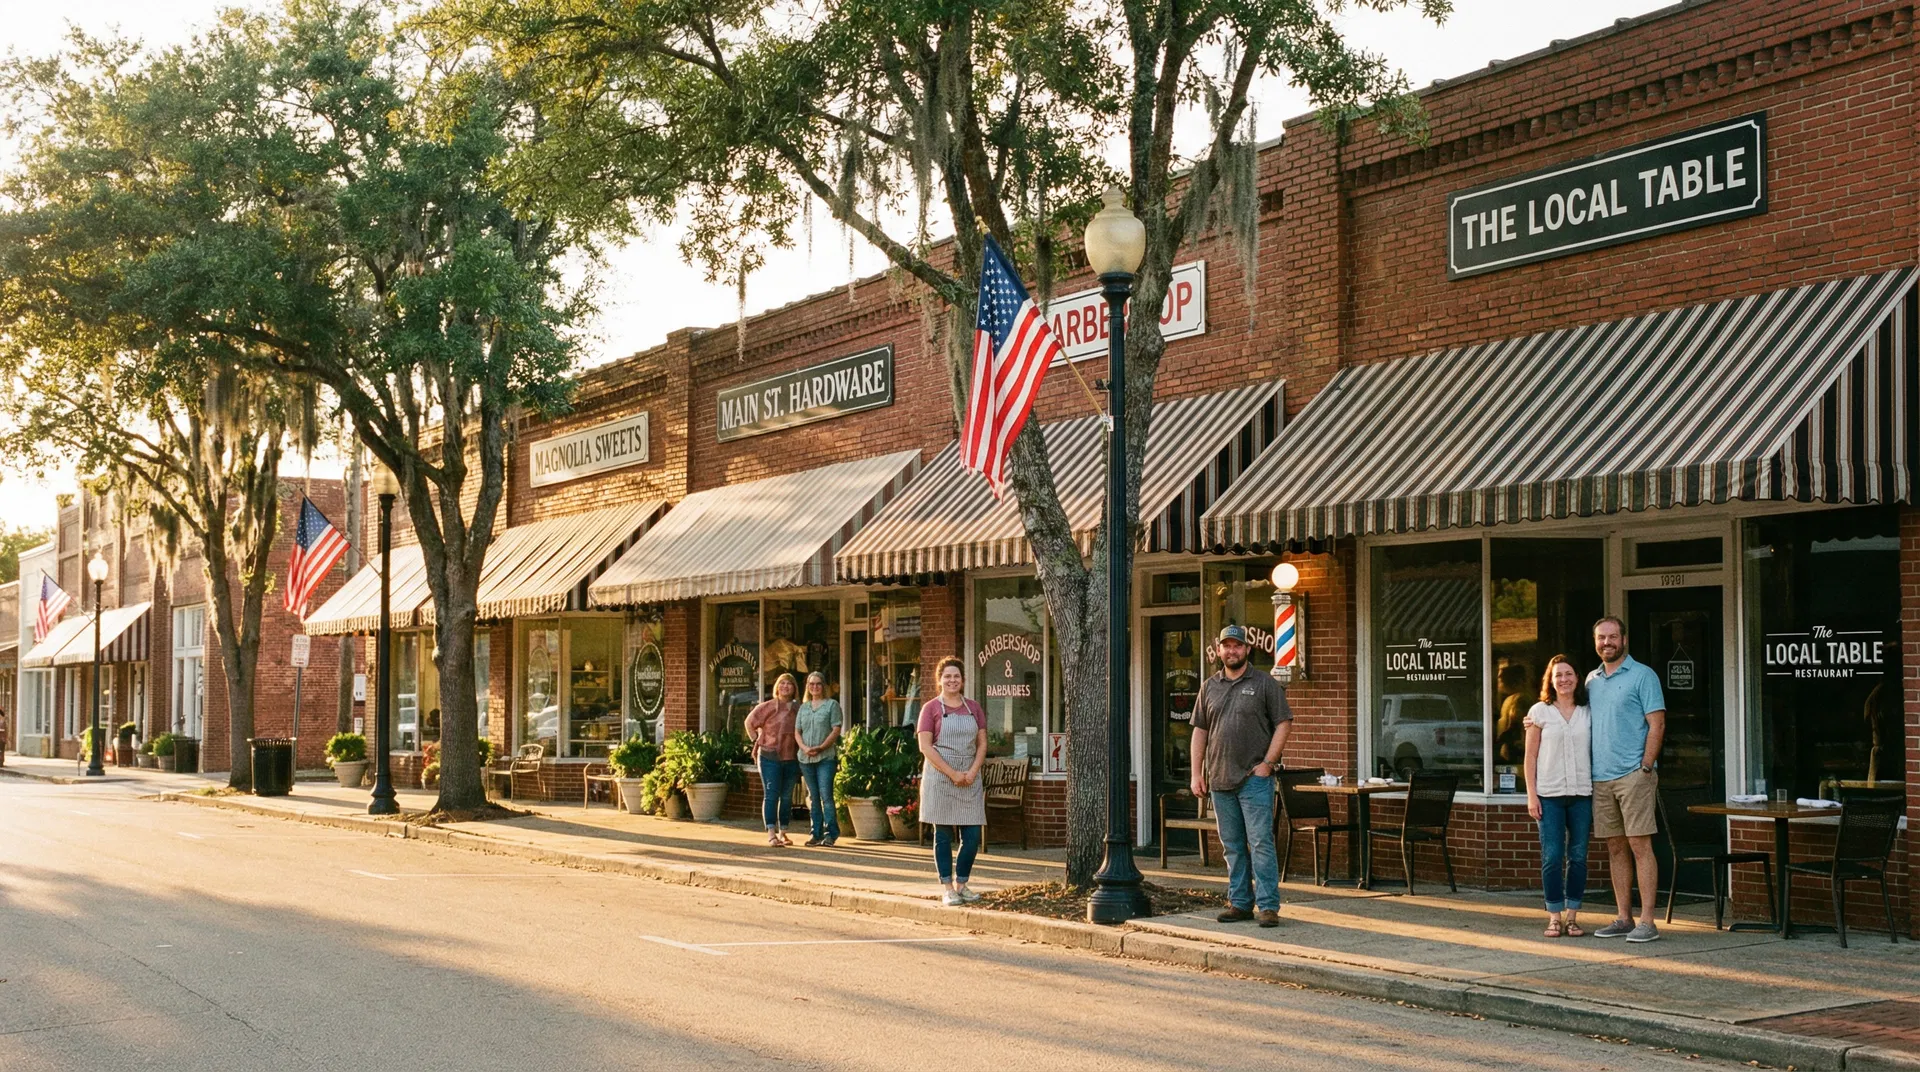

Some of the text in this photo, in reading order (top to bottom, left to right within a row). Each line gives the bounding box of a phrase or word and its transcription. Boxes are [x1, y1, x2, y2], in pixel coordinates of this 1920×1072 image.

[1461, 147, 1746, 250] THE LOCAL TABLE
[721, 359, 885, 431] MAIN ST. HARDWARE
[535, 425, 642, 477] MAGNOLIA SWEETS
[1812, 625, 1834, 639] The
[978, 633, 1041, 667] BARBERSHOP
[1418, 638, 1433, 649] The
[1766, 641, 1884, 665] LOCAL TABLE
[1004, 659, 1014, 678] &
[1386, 651, 1467, 671] LOCAL TABLE
[1795, 668, 1854, 678] RESTAURANT
